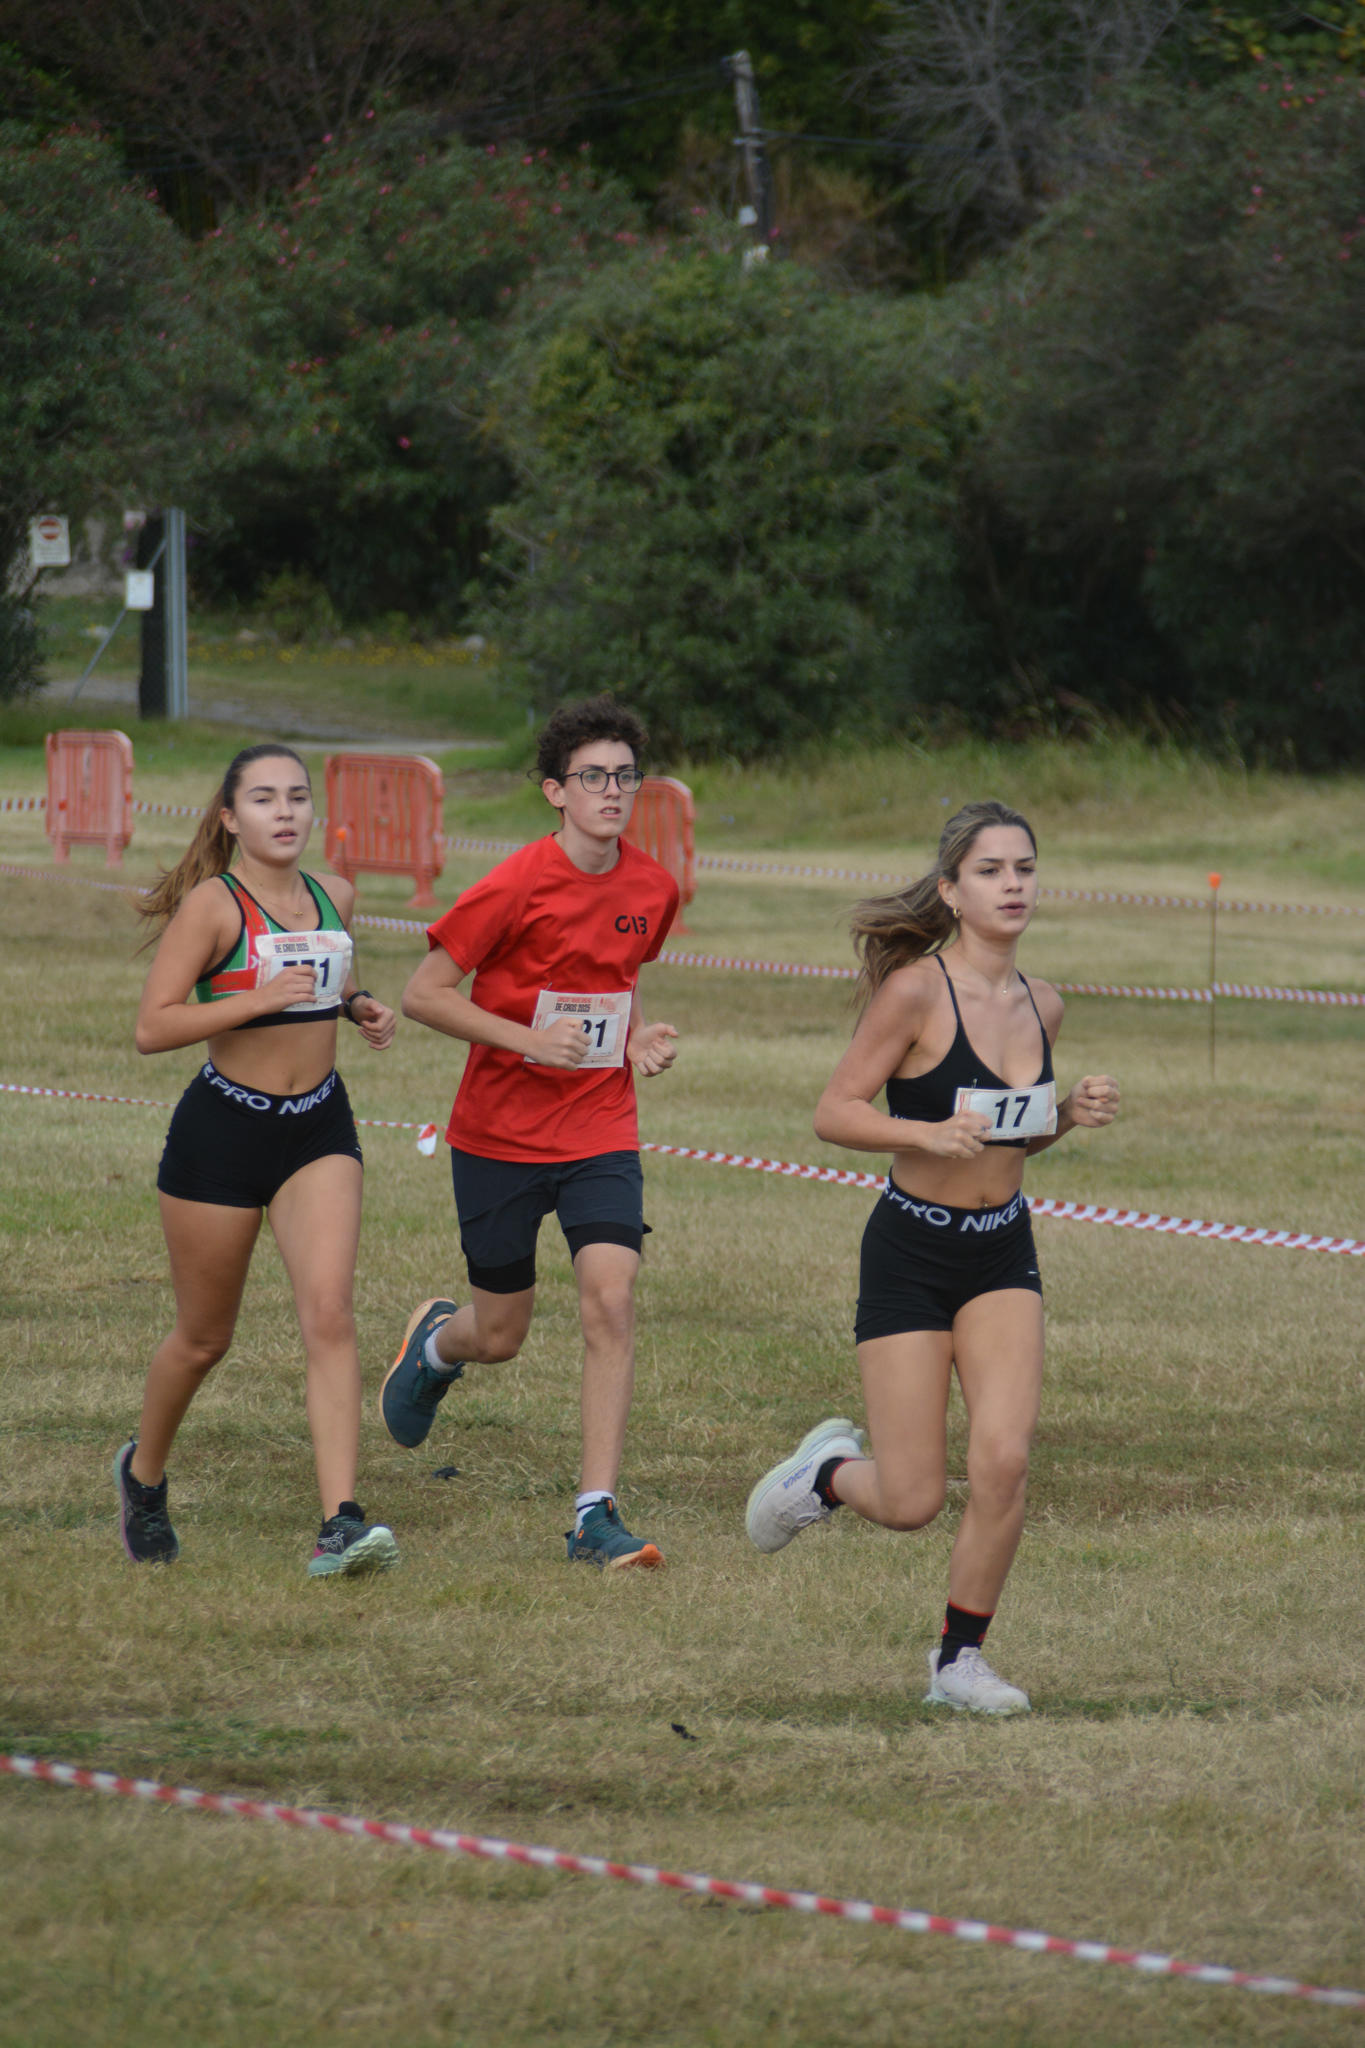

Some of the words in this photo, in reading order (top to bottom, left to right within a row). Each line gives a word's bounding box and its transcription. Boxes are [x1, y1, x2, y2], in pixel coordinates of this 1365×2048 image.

[210, 1076, 271, 1110] PRO
[279, 1078, 331, 1114] NIKE
[994, 1095, 1031, 1129] 17
[960, 1199, 1019, 1232] NIKE
